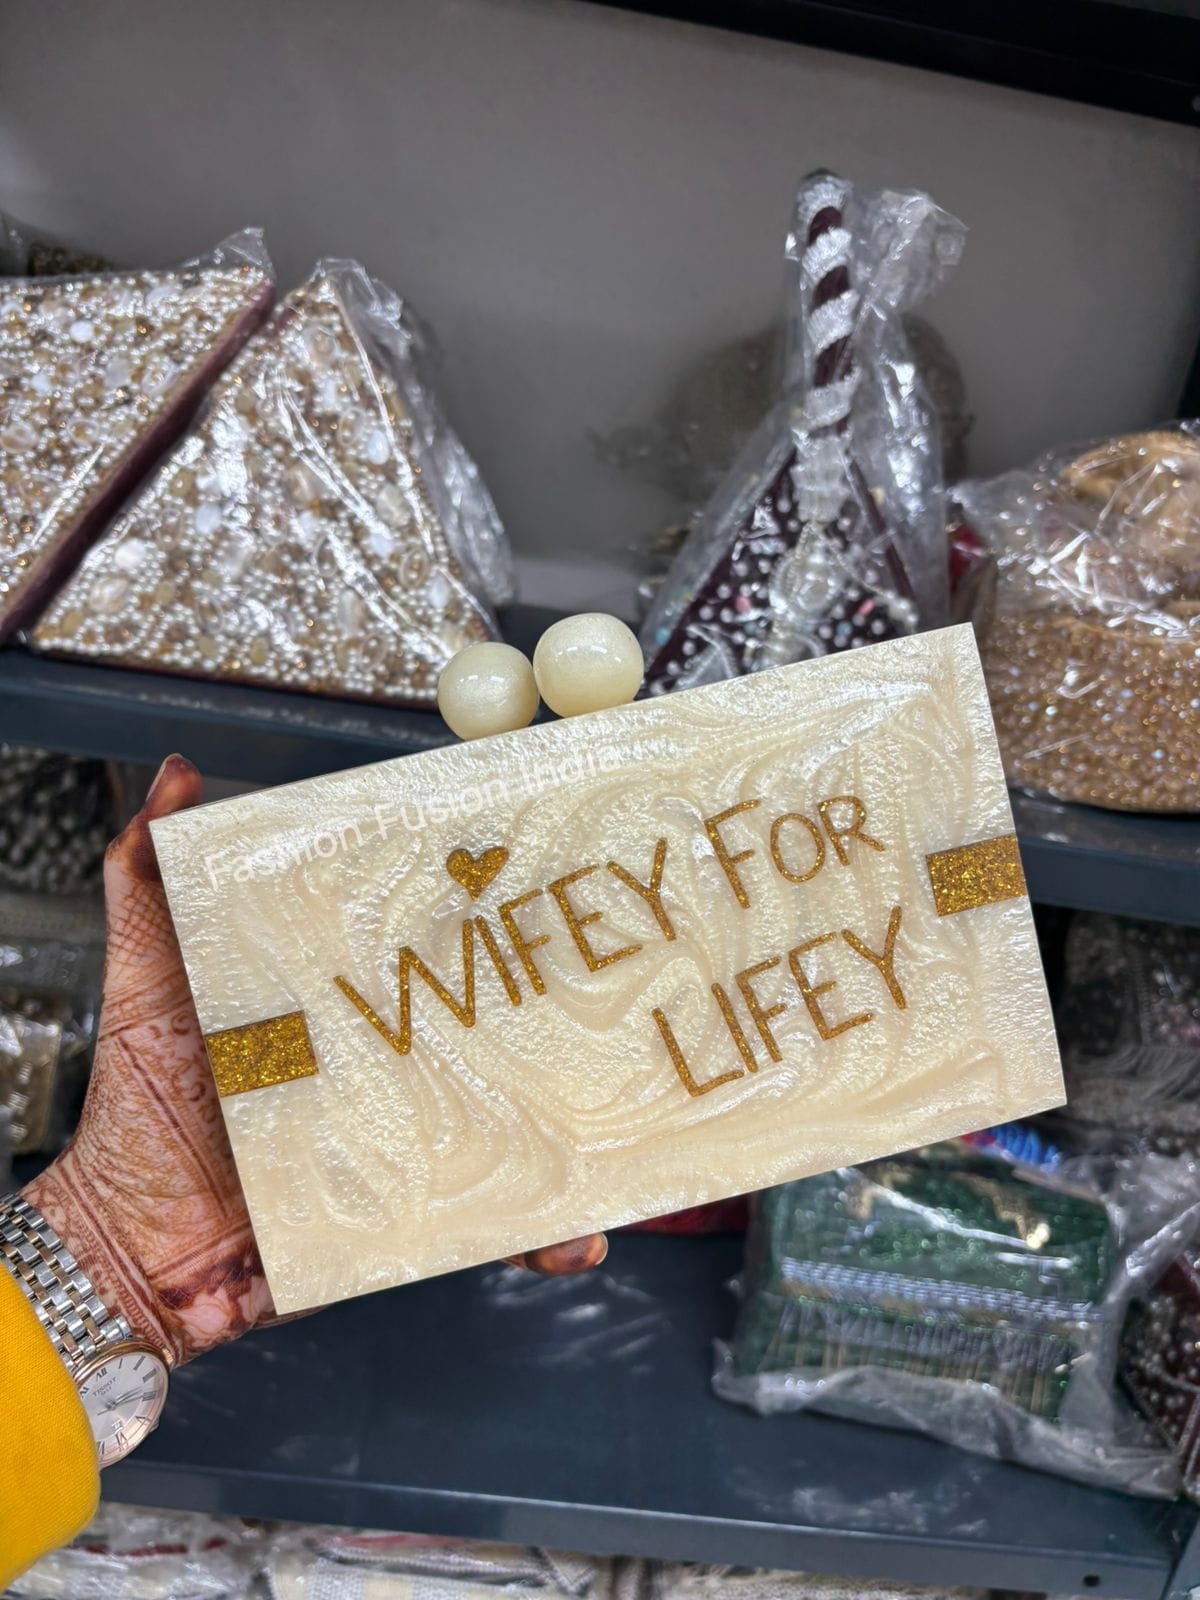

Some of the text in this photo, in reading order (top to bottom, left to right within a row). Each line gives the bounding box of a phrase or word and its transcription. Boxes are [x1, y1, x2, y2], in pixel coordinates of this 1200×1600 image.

[333, 795, 886, 1056] WIFEY FOR
[652, 905, 907, 1098] LIFEY
